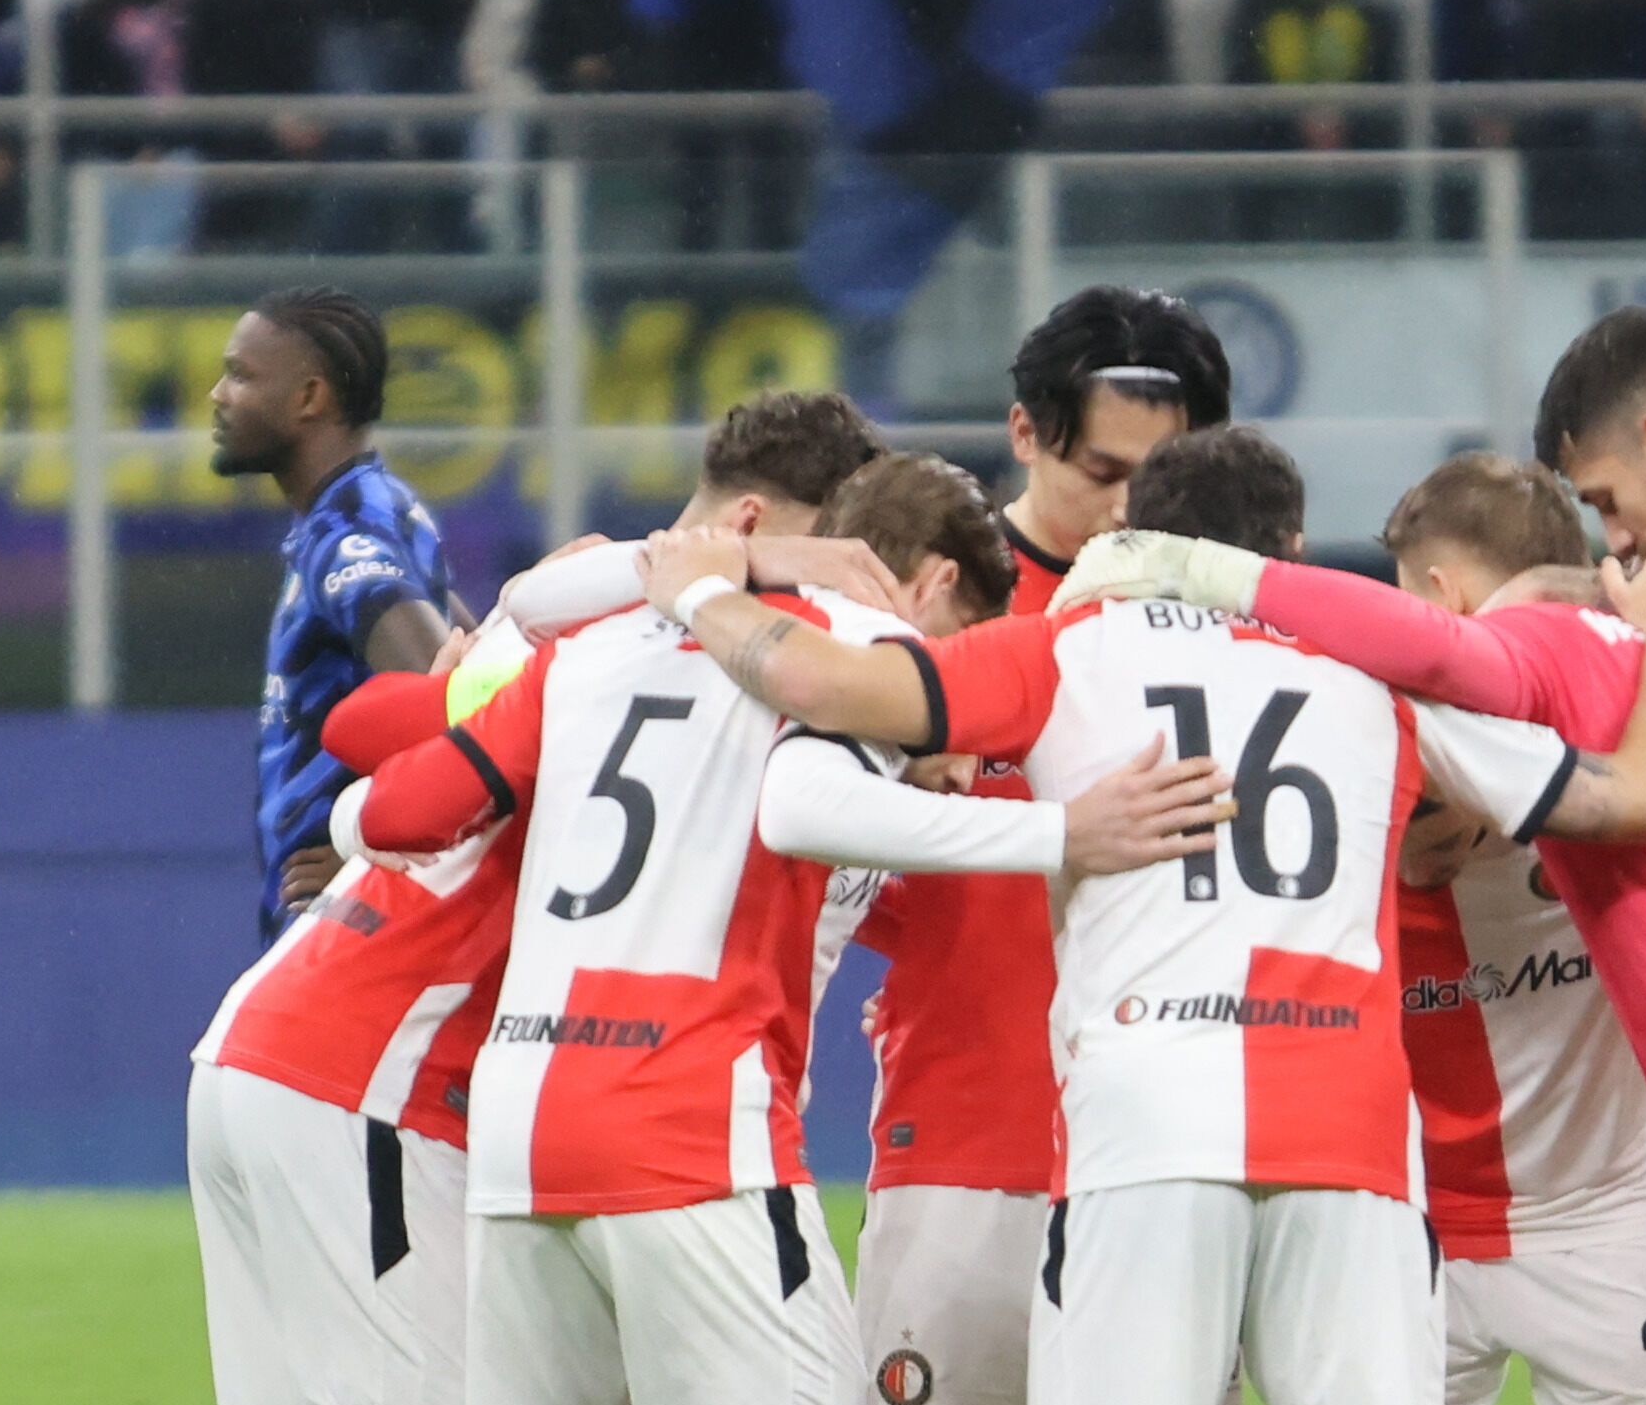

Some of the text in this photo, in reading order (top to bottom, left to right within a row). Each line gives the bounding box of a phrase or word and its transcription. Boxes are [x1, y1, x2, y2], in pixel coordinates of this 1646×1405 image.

[546, 693, 697, 921] 5
[1144, 683, 1339, 902] 16
[492, 1014, 666, 1048] FOUNDATION
[1157, 993, 1360, 1029] FOUNDATION
